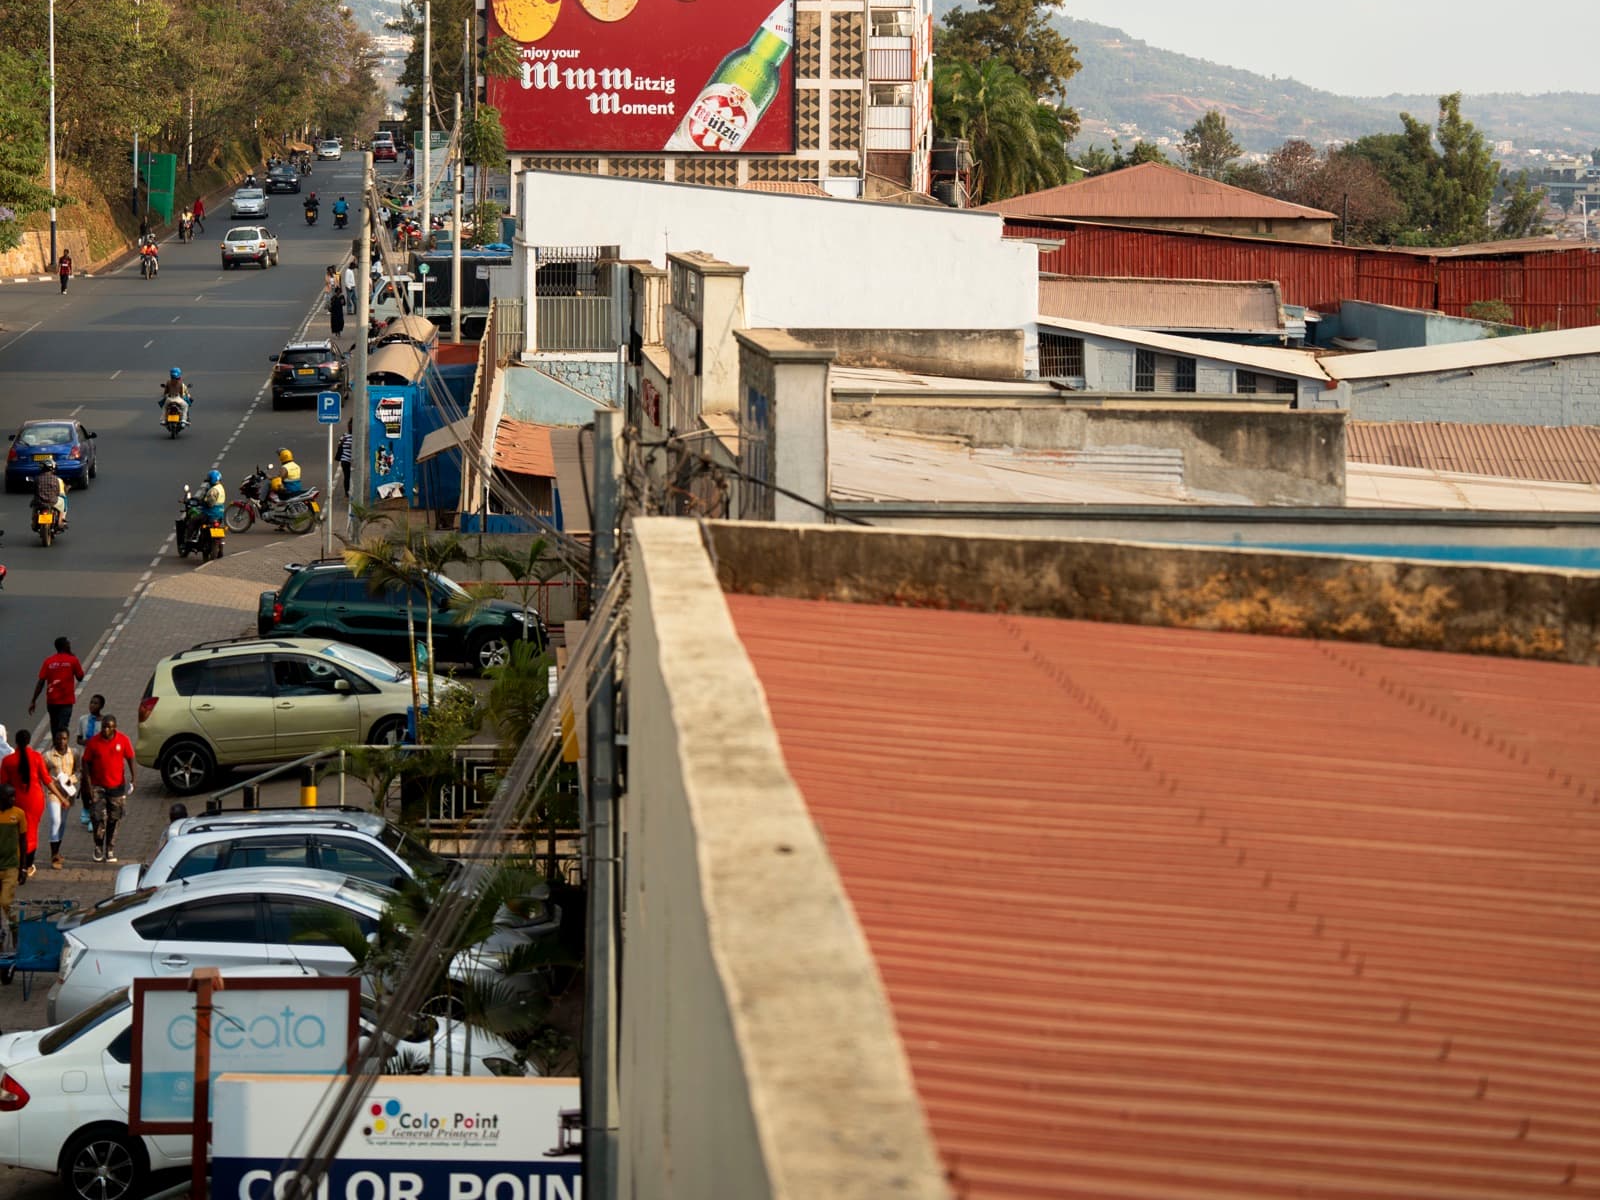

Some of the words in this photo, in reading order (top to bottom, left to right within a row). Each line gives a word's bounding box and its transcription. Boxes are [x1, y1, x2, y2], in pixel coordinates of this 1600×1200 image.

[516, 47, 550, 61] Enjoy
[552, 48, 581, 61] your
[586, 92, 675, 115] Moment
[323, 397, 335, 411] P
[167, 1005, 326, 1051] ceata
[399, 1112, 448, 1129] Color
[454, 1112, 499, 1129] Point
[392, 1128, 434, 1137] General
[437, 1129, 479, 1138] Printers
[482, 1129, 500, 1139] Ltd
[449, 1172, 582, 1200] POIN
